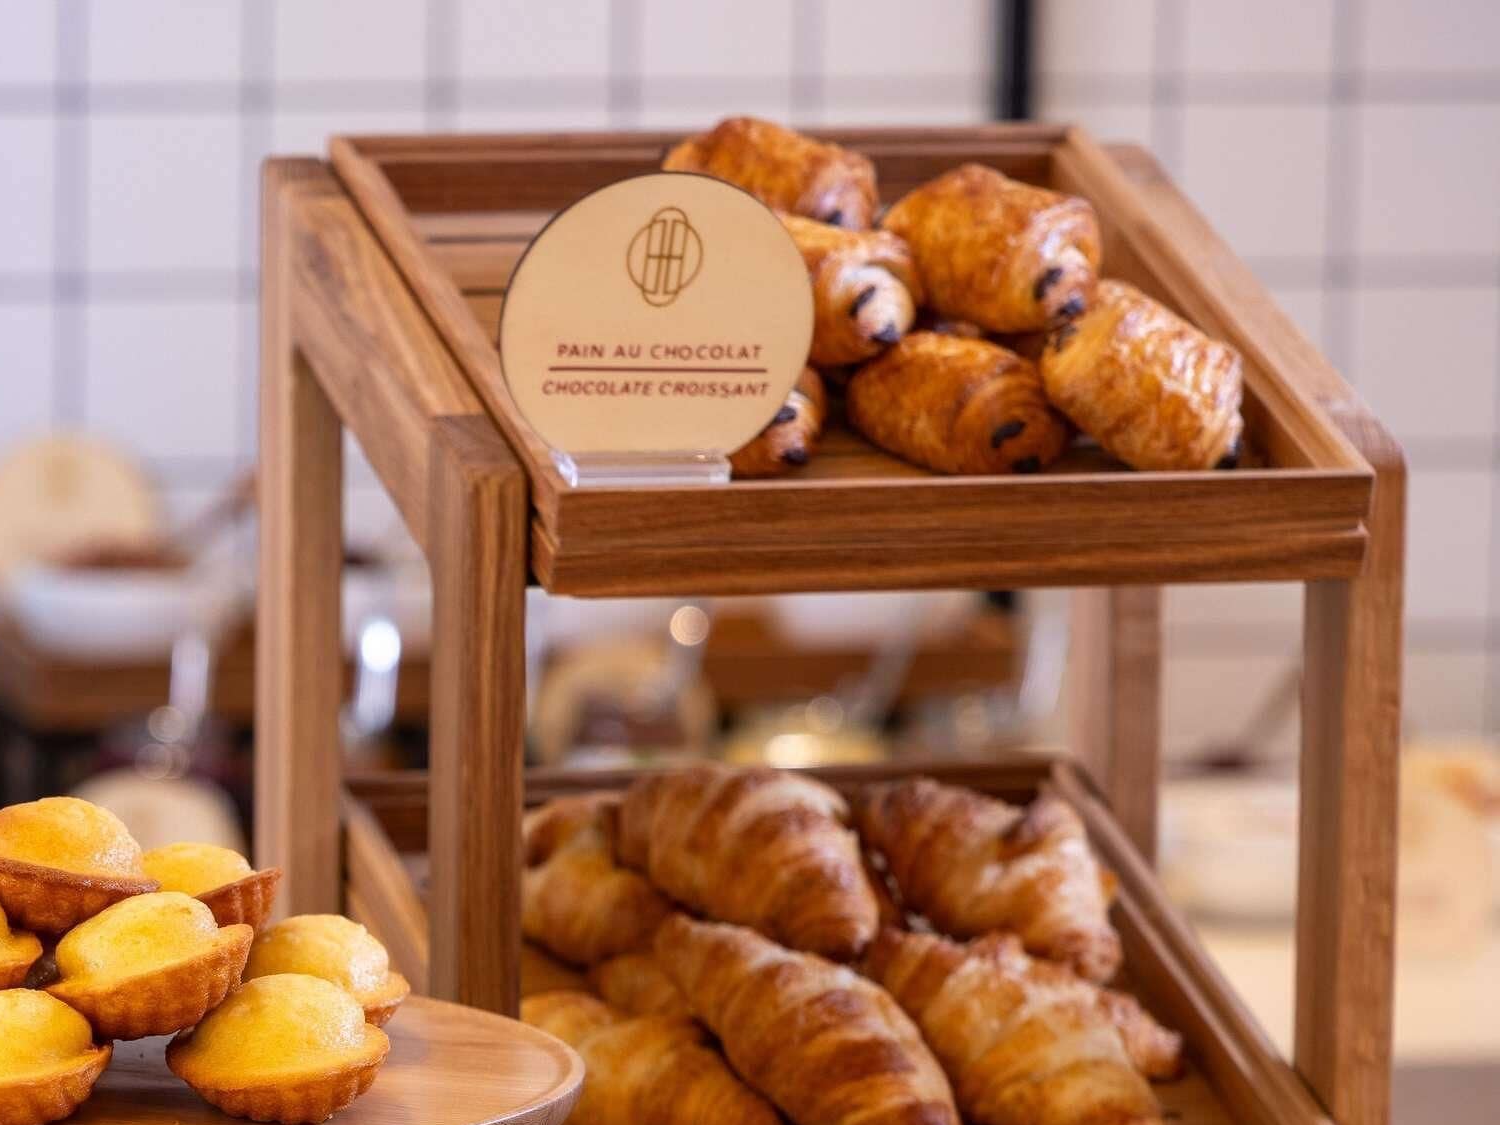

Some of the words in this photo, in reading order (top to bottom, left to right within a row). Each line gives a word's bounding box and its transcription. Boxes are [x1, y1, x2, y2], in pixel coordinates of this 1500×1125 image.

[556, 343, 605, 360] PAIN
[614, 344, 642, 360] AU
[650, 344, 763, 361] CHOCOLAT
[542, 379, 653, 397] CHOCOLATE
[658, 380, 771, 399] CROISSANT
